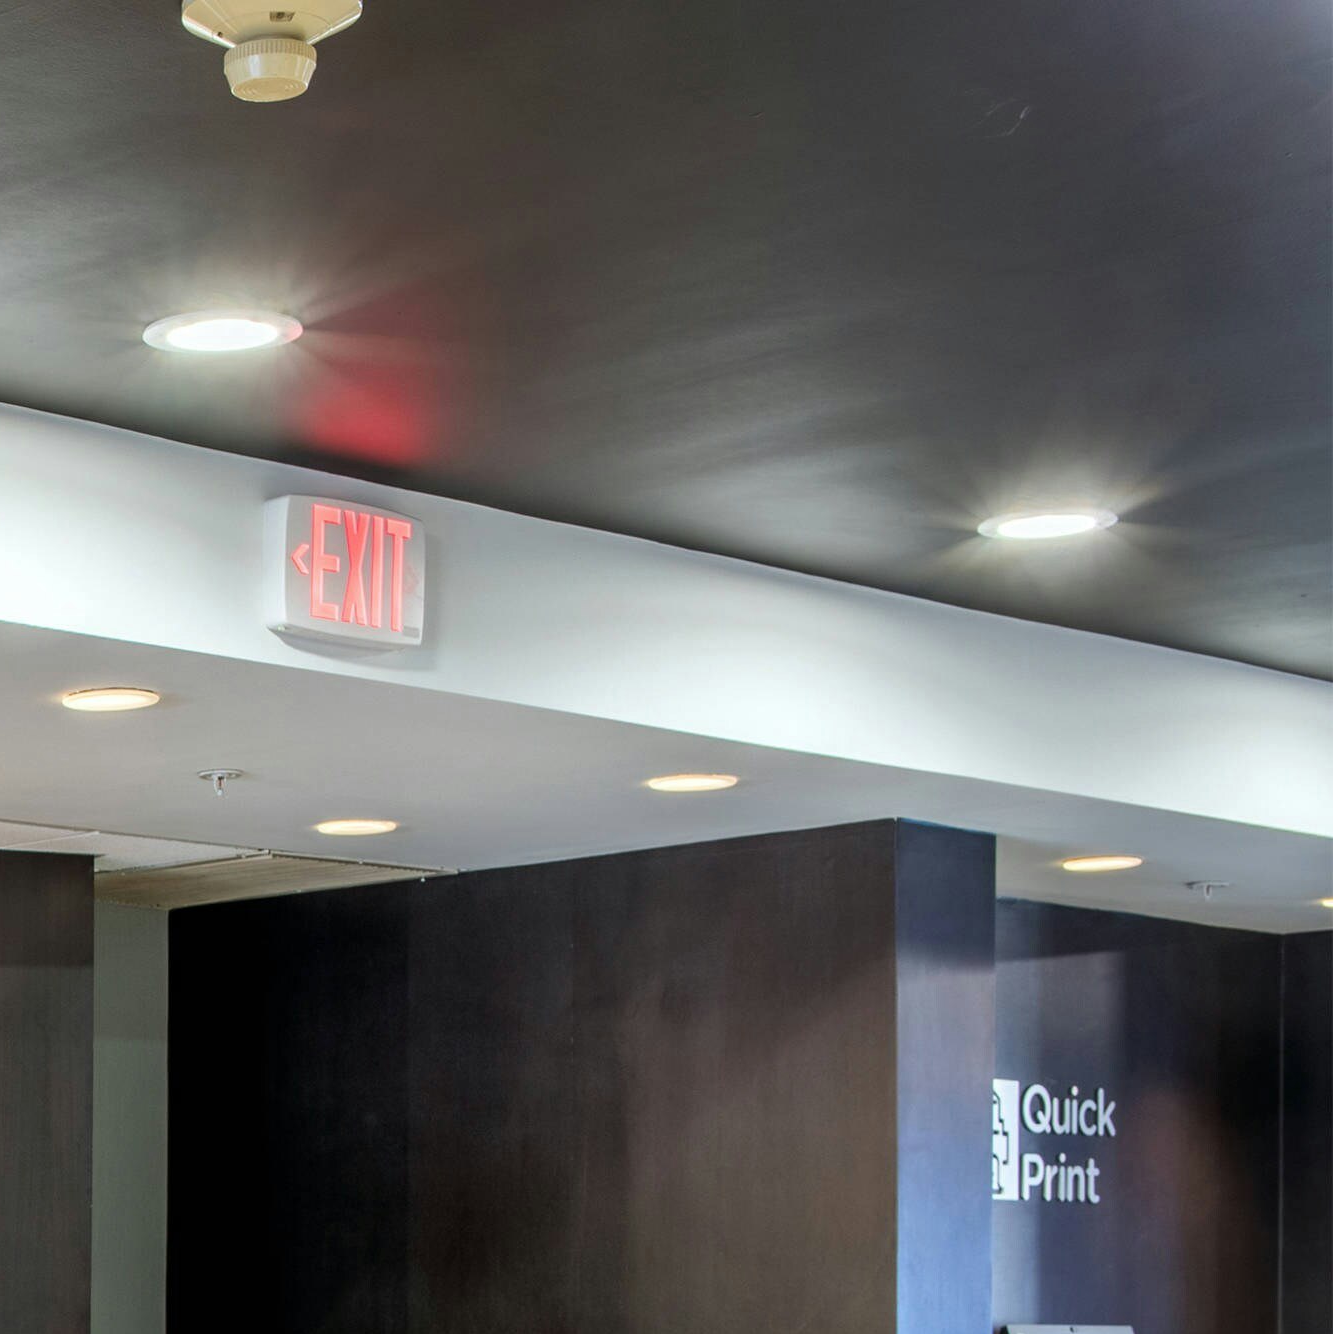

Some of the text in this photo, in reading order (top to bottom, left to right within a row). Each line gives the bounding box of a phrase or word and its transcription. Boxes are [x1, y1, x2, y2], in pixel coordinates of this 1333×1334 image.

[310, 503, 411, 632] EXIT
[1022, 1083, 1116, 1136] Quick
[1021, 1152, 1100, 1204] Print
